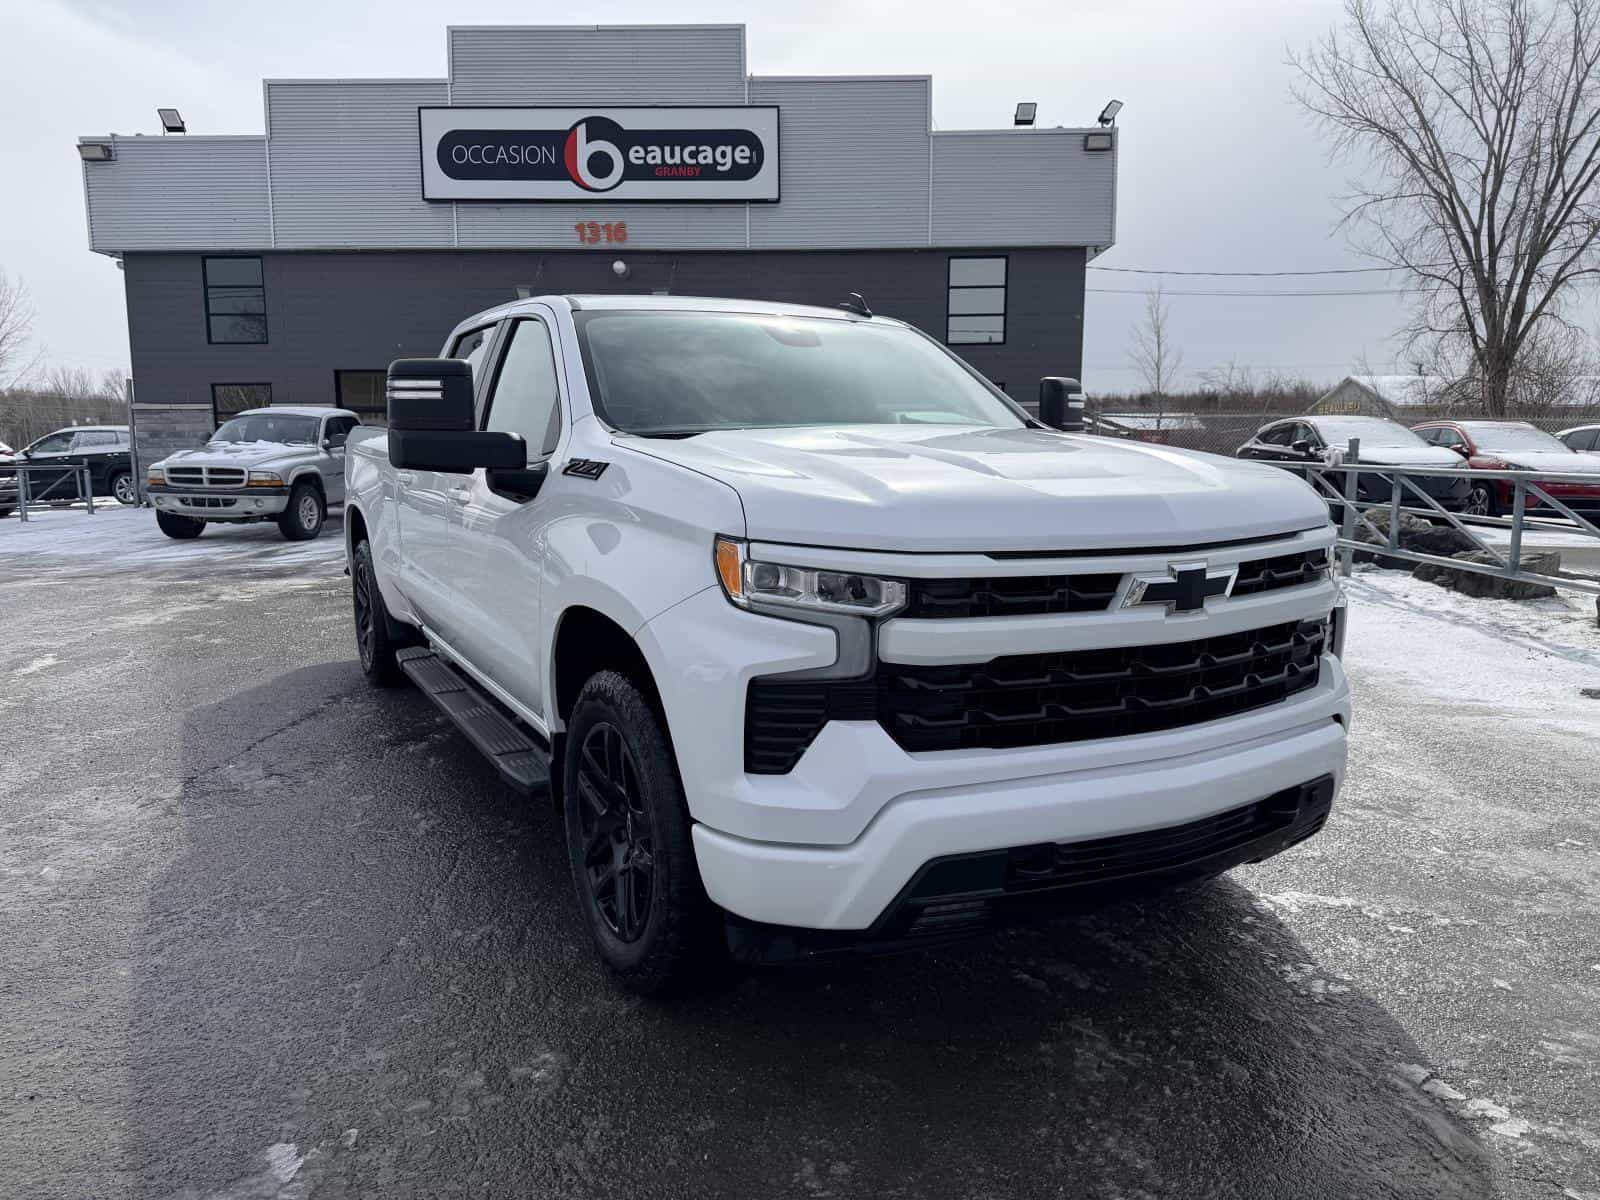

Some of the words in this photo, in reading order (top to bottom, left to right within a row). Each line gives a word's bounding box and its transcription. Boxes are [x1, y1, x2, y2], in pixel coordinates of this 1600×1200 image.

[452, 144, 556, 165] OCCASION
[655, 166, 701, 177] GRANBY
[575, 221, 628, 245] 1316
